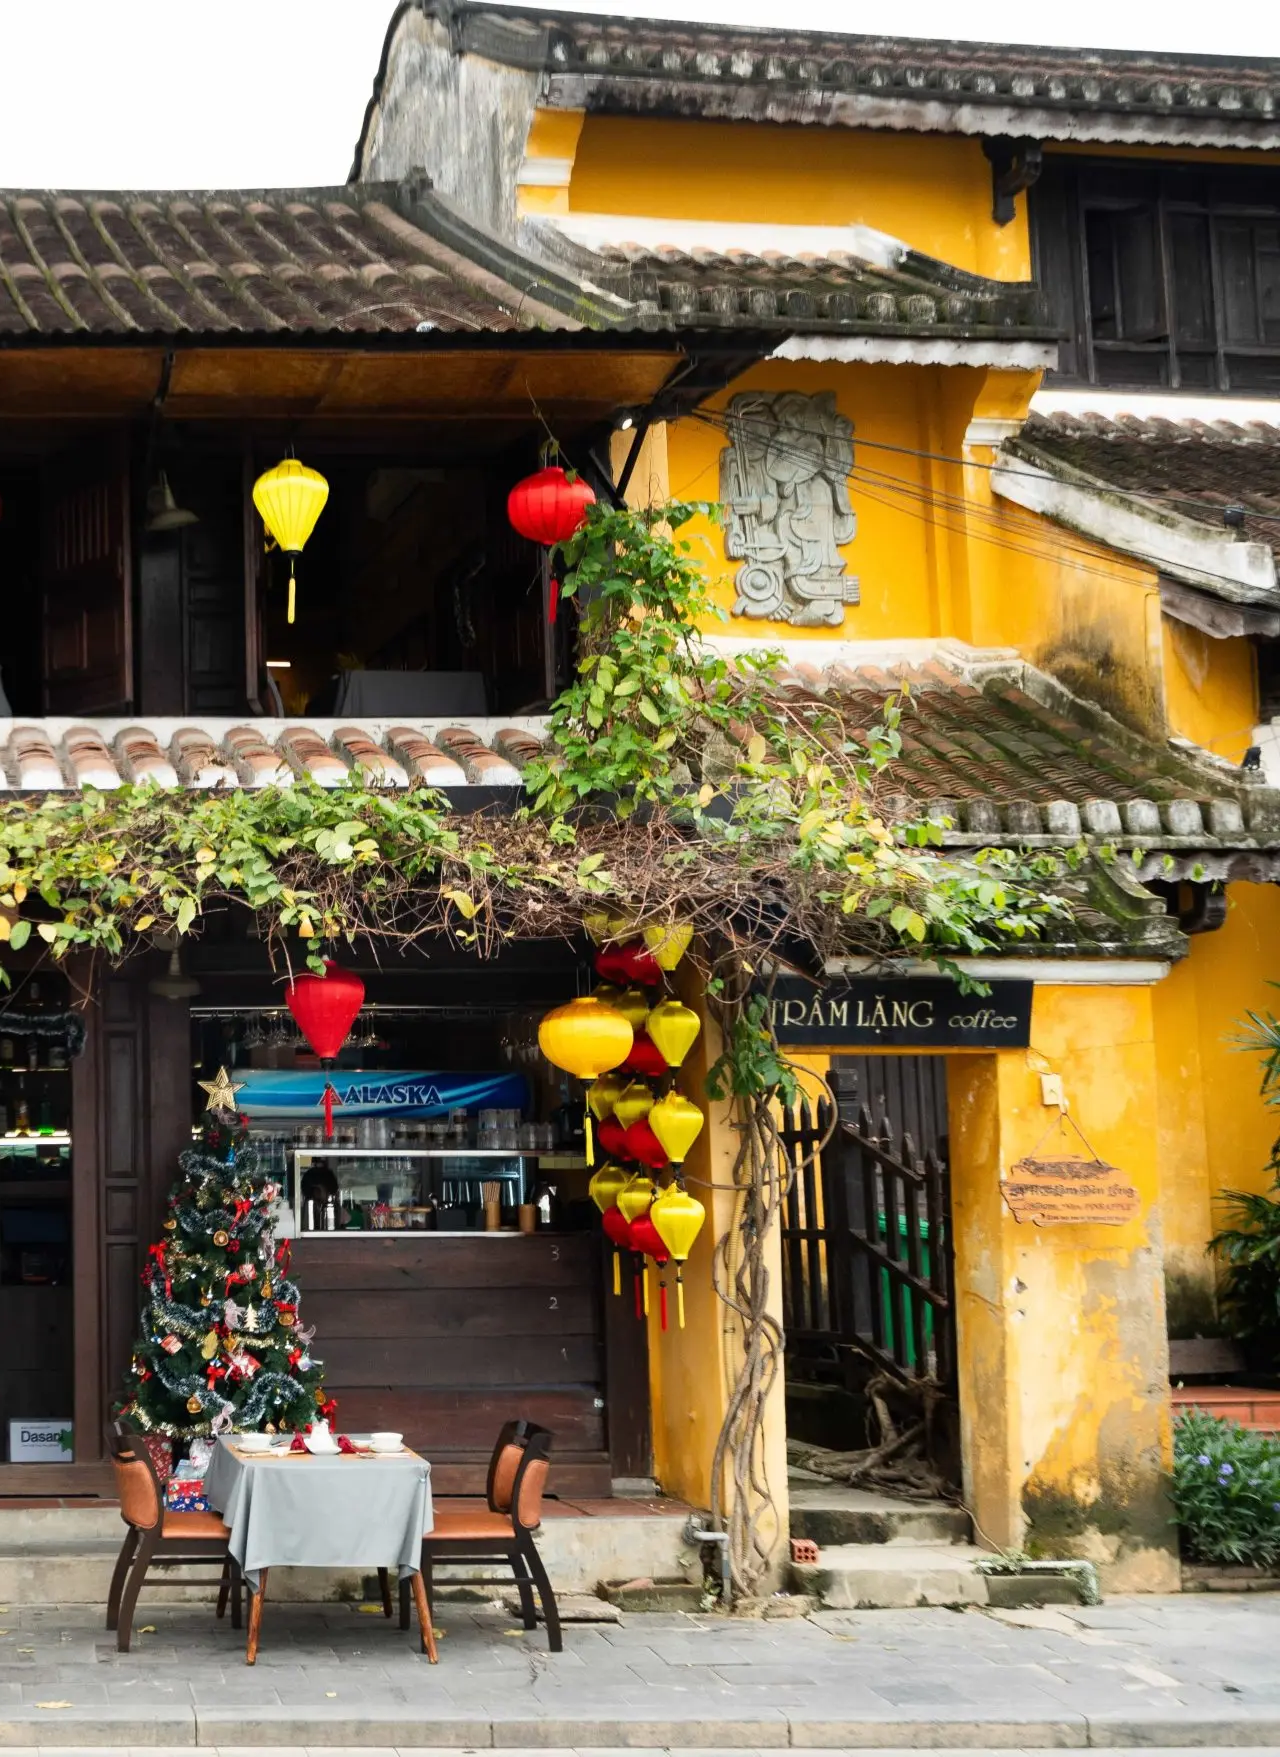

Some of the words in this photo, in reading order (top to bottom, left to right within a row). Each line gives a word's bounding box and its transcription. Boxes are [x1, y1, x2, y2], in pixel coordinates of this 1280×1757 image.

[856, 995, 934, 1034] LẶNG
[948, 1009, 1018, 1029] coffee
[344, 1084, 444, 1105] ALASKA
[549, 1244, 561, 1262] 3
[548, 1295, 560, 1310] 2
